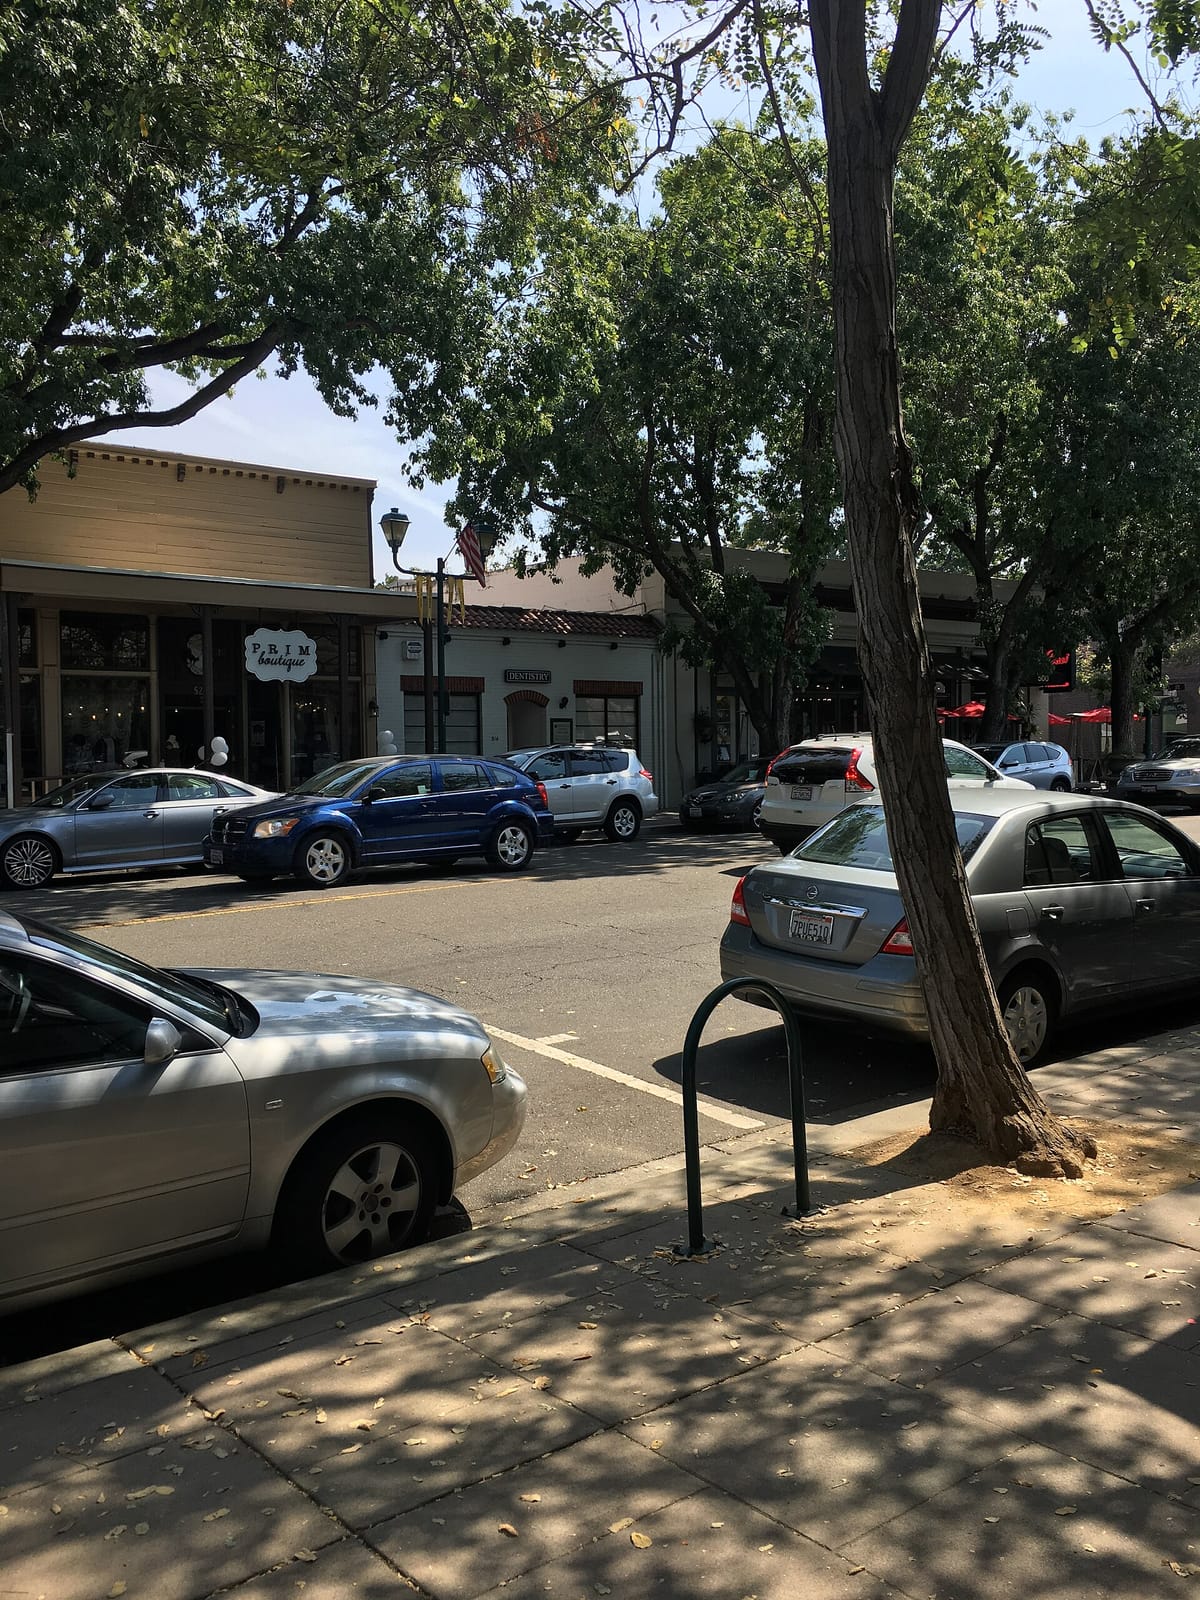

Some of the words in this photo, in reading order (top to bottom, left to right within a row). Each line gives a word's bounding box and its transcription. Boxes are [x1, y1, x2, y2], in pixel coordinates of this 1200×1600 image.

[252, 643, 311, 656] PRIM
[258, 651, 305, 672] boutique
[509, 672, 549, 681] DENTISTRY
[193, 686, 205, 696] 52
[792, 920, 829, 939] 7PUE510
